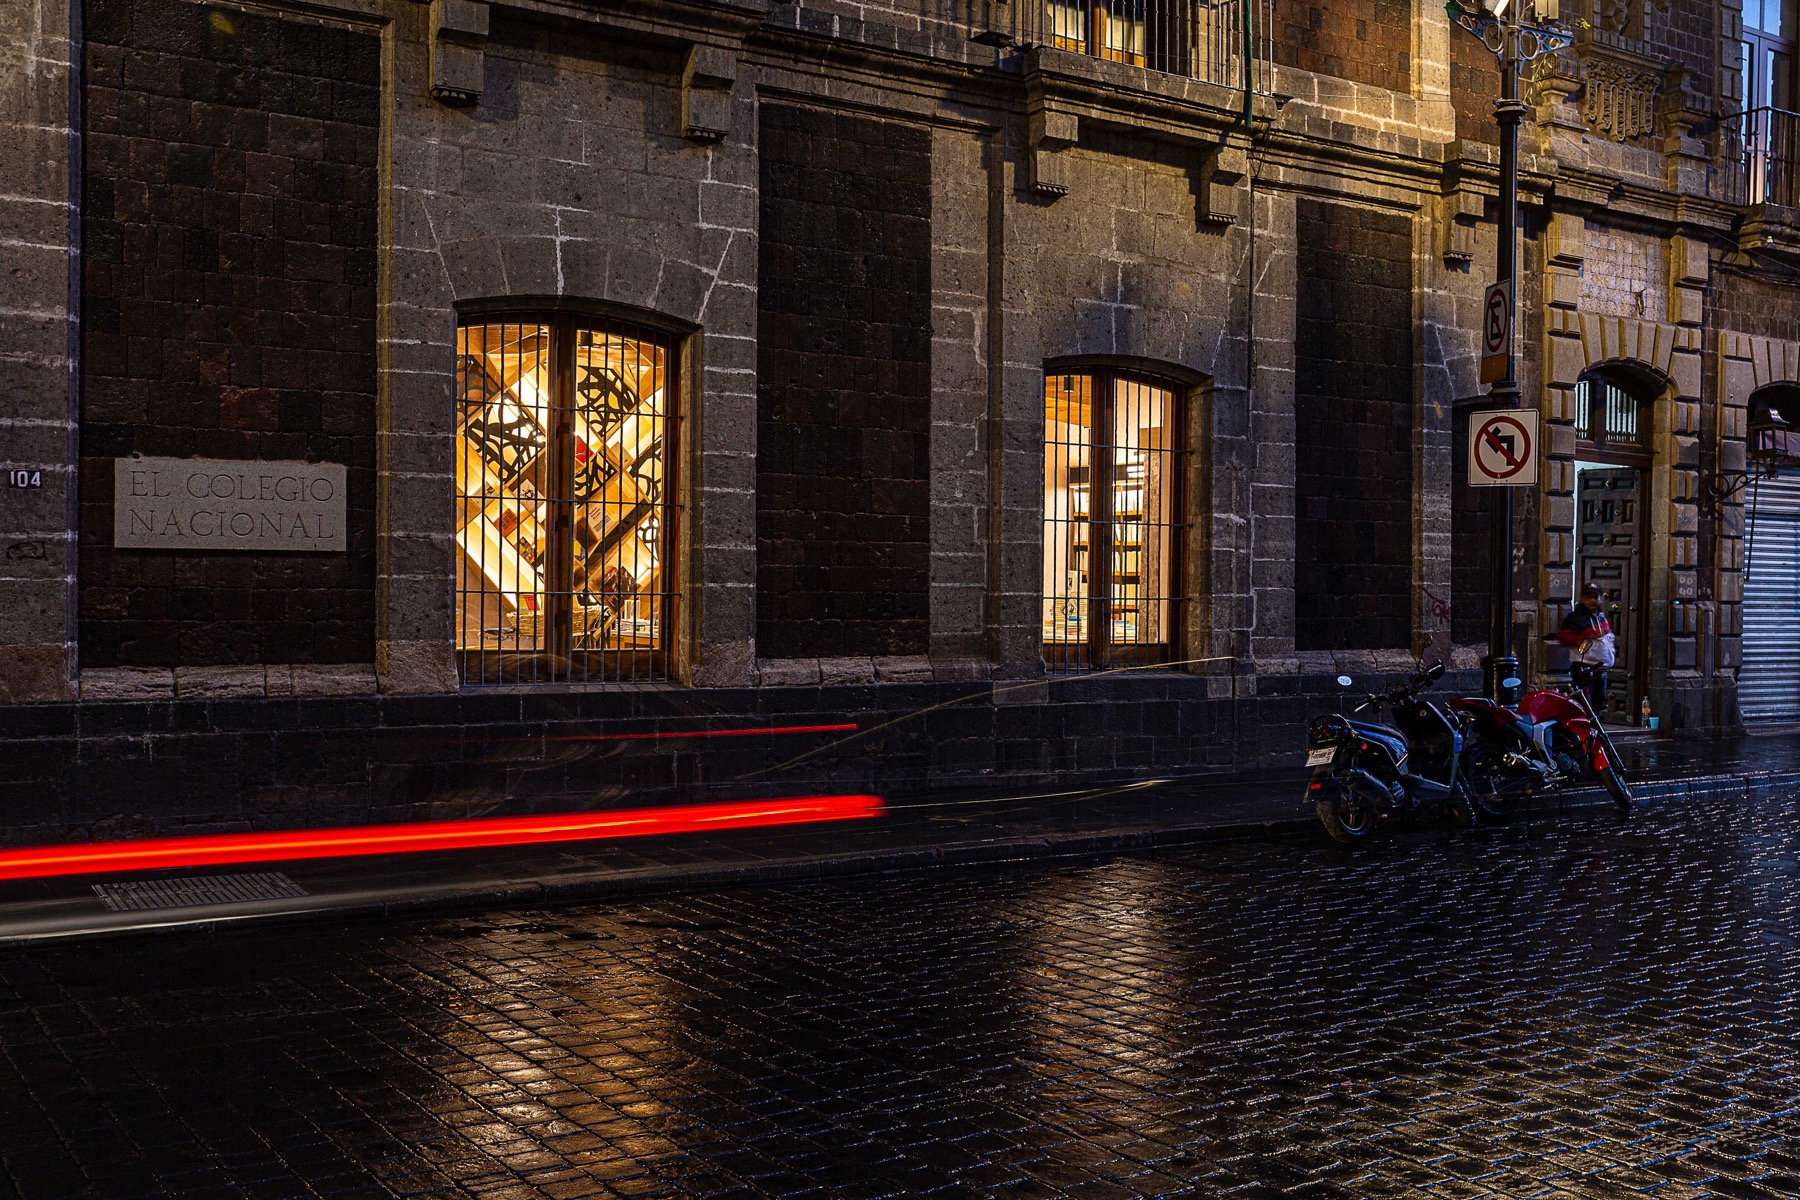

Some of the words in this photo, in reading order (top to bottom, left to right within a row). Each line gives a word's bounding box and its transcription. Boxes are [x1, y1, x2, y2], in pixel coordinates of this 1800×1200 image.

[10, 471, 41, 487] 104
[130, 470, 170, 497] EL
[187, 473, 334, 502] COLEGIO
[129, 509, 334, 539] NACIONAL
